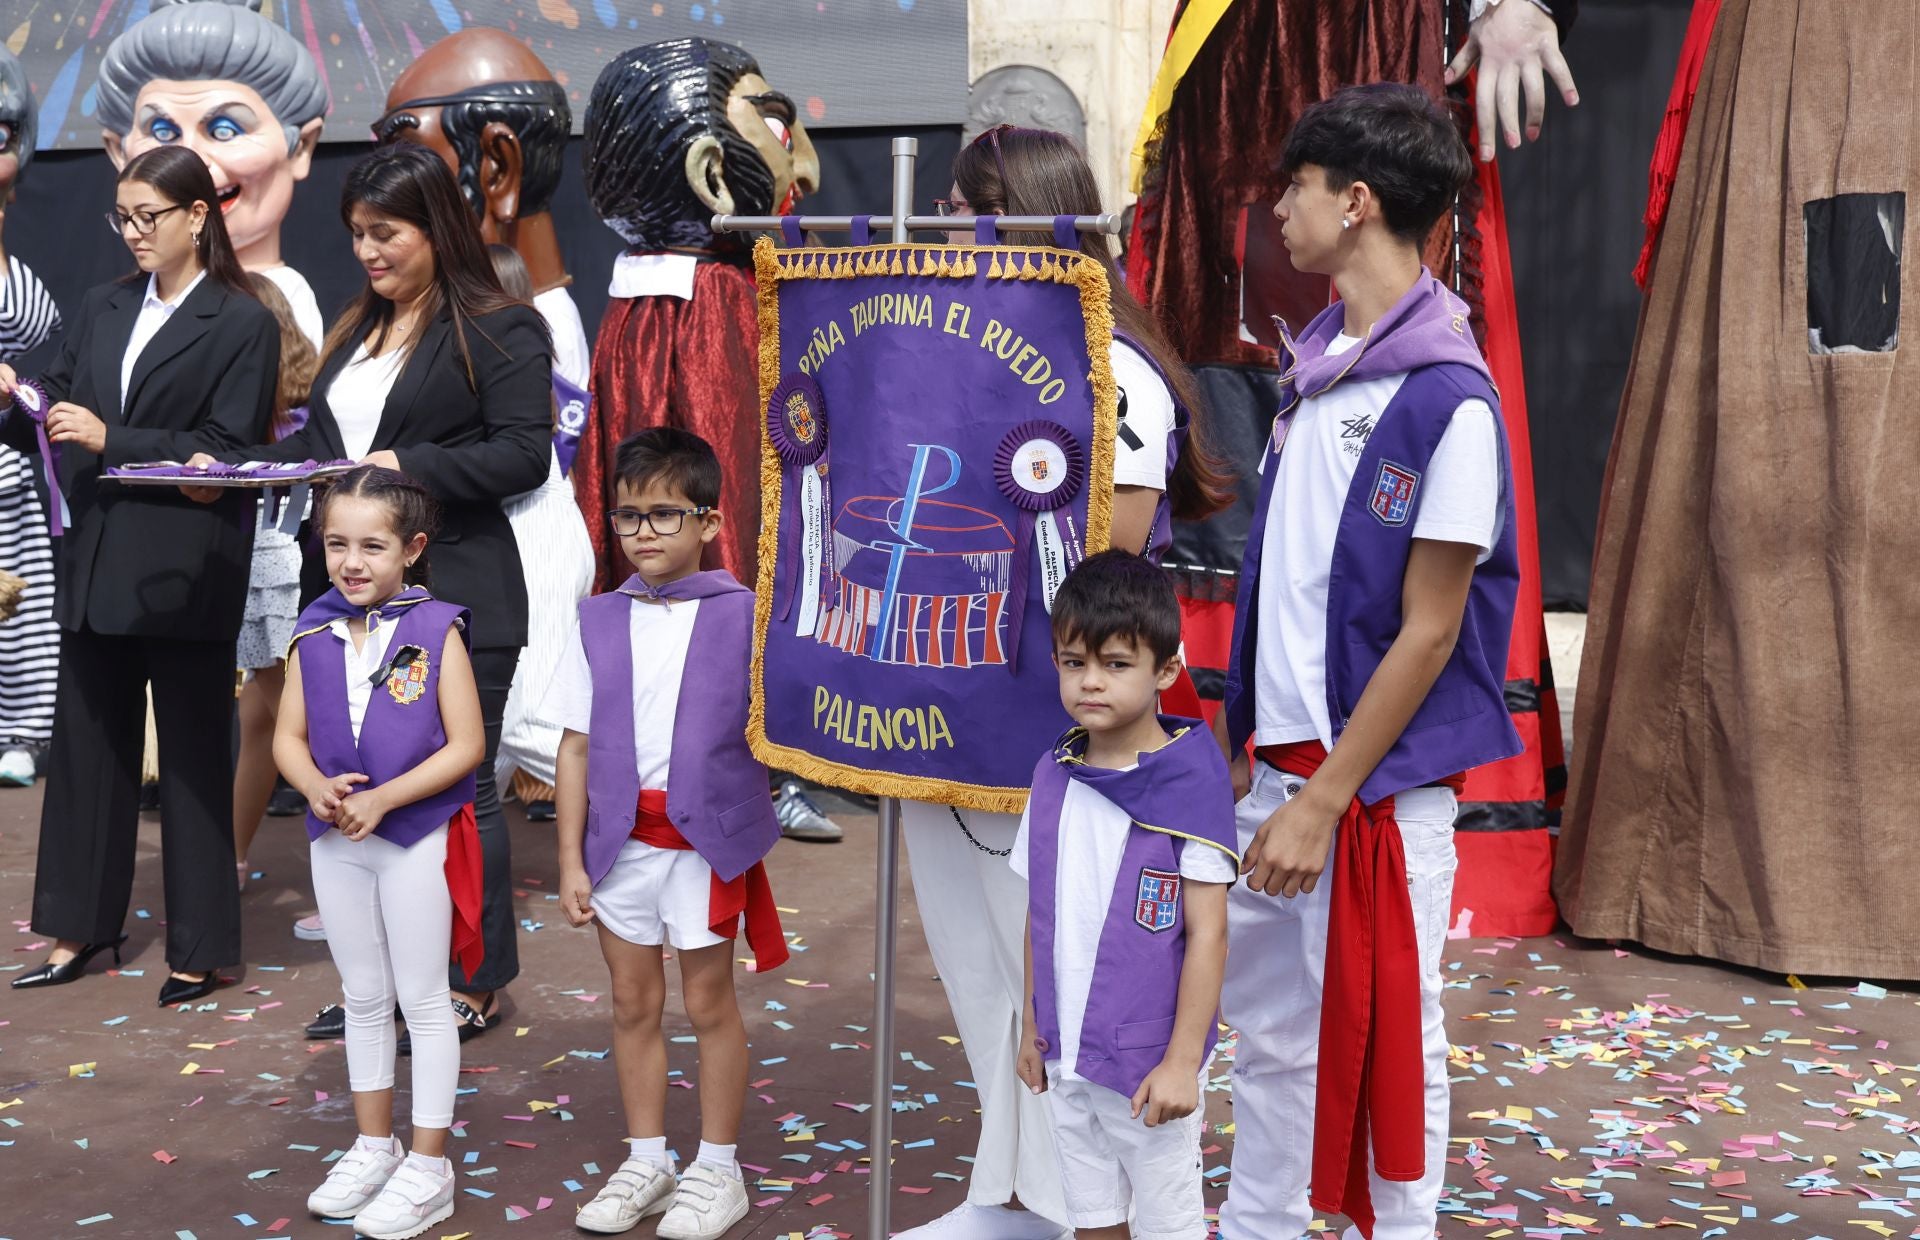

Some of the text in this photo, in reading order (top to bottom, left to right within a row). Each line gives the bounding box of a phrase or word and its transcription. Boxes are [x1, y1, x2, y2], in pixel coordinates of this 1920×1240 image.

[798, 293, 1066, 404] PEÑA TAURINA EL RUEDO
[808, 531, 814, 543] De
[1041, 520, 1049, 546] Ciudad
[1047, 570, 1053, 581] De
[1050, 551, 1059, 588] PALENCIA
[1047, 581, 1054, 591] La
[813, 685, 954, 750] PALENCIA
